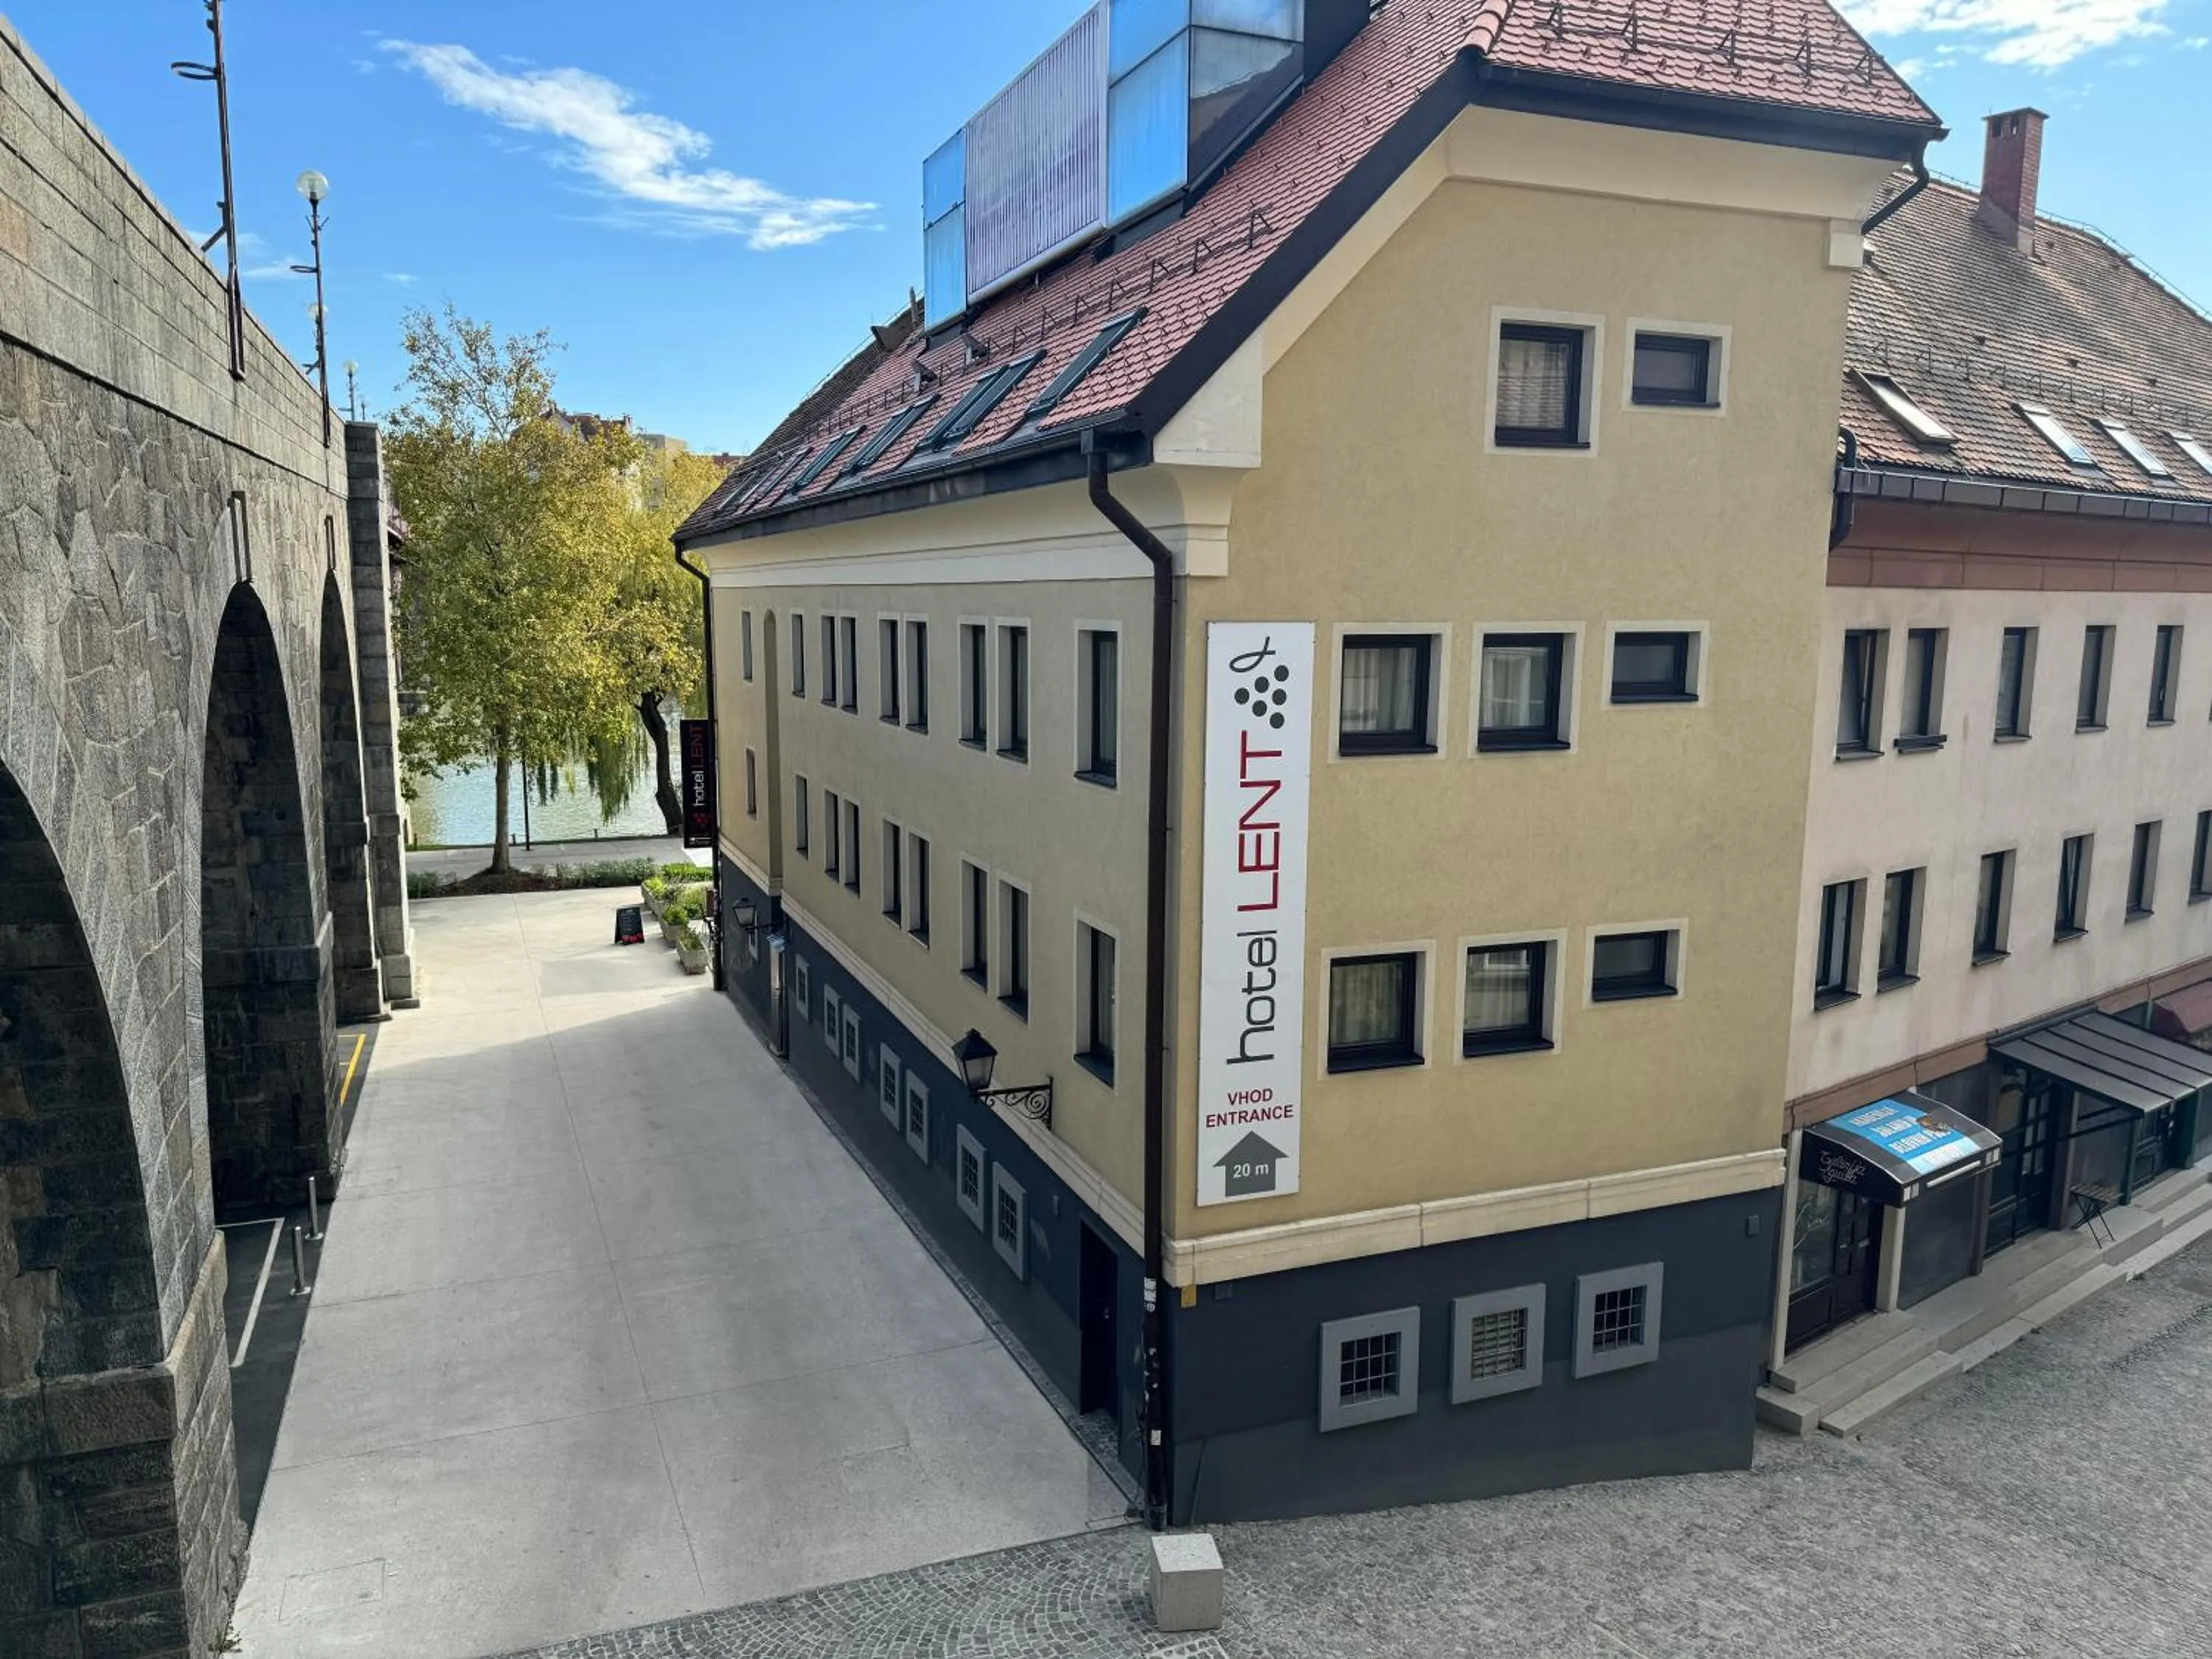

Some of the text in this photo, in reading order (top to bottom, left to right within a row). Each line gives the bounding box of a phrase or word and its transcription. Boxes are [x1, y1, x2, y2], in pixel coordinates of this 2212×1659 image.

[689, 725, 706, 807] hotel LENT
[1225, 729, 1282, 1065] hotel LENT
[1228, 1088, 1273, 1106] VHOD
[1206, 1105, 1294, 1128] ENTRANCE
[1233, 1163, 1269, 1178] 20 m
